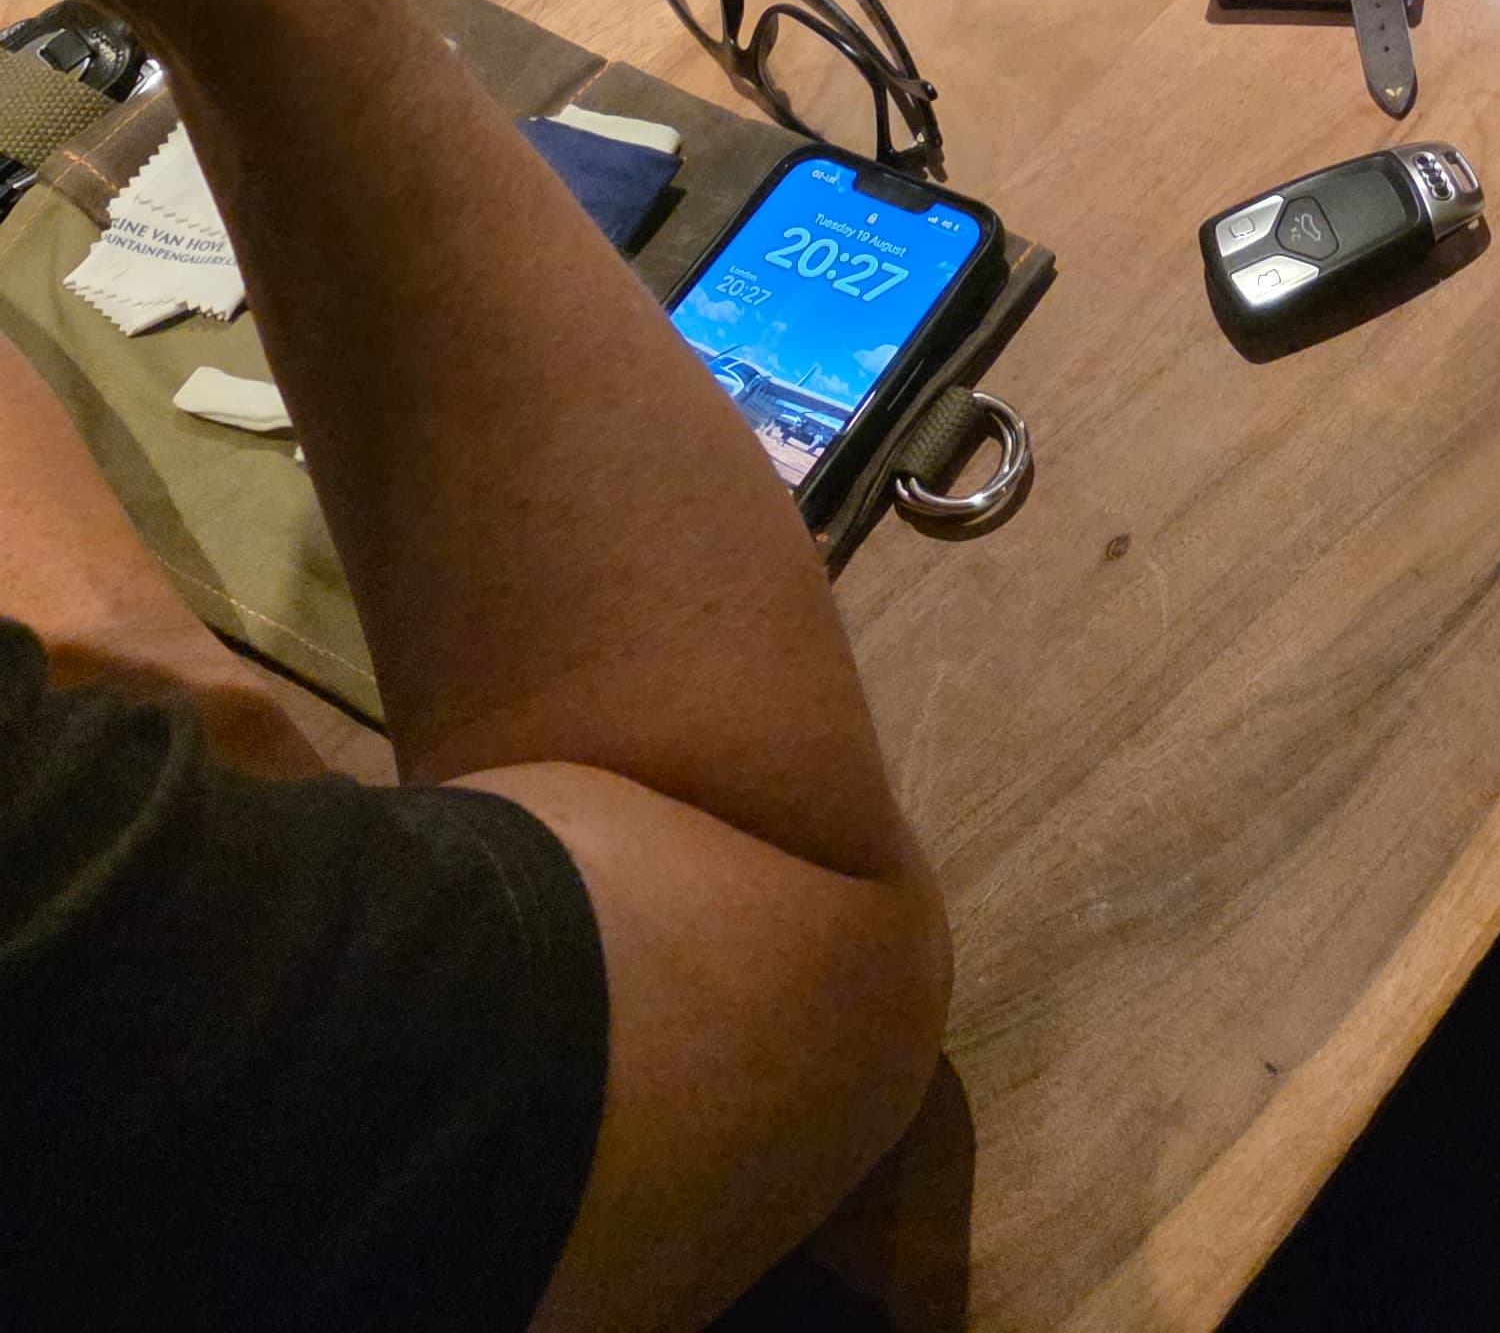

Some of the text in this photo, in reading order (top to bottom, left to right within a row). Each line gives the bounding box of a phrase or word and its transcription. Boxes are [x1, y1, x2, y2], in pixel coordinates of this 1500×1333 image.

[152, 228, 185, 247] VAN
[814, 213, 908, 258] Tuesday 19 August
[729, 265, 758, 282] London
[764, 227, 910, 302] 20:27
[716, 275, 773, 306] 20:27
